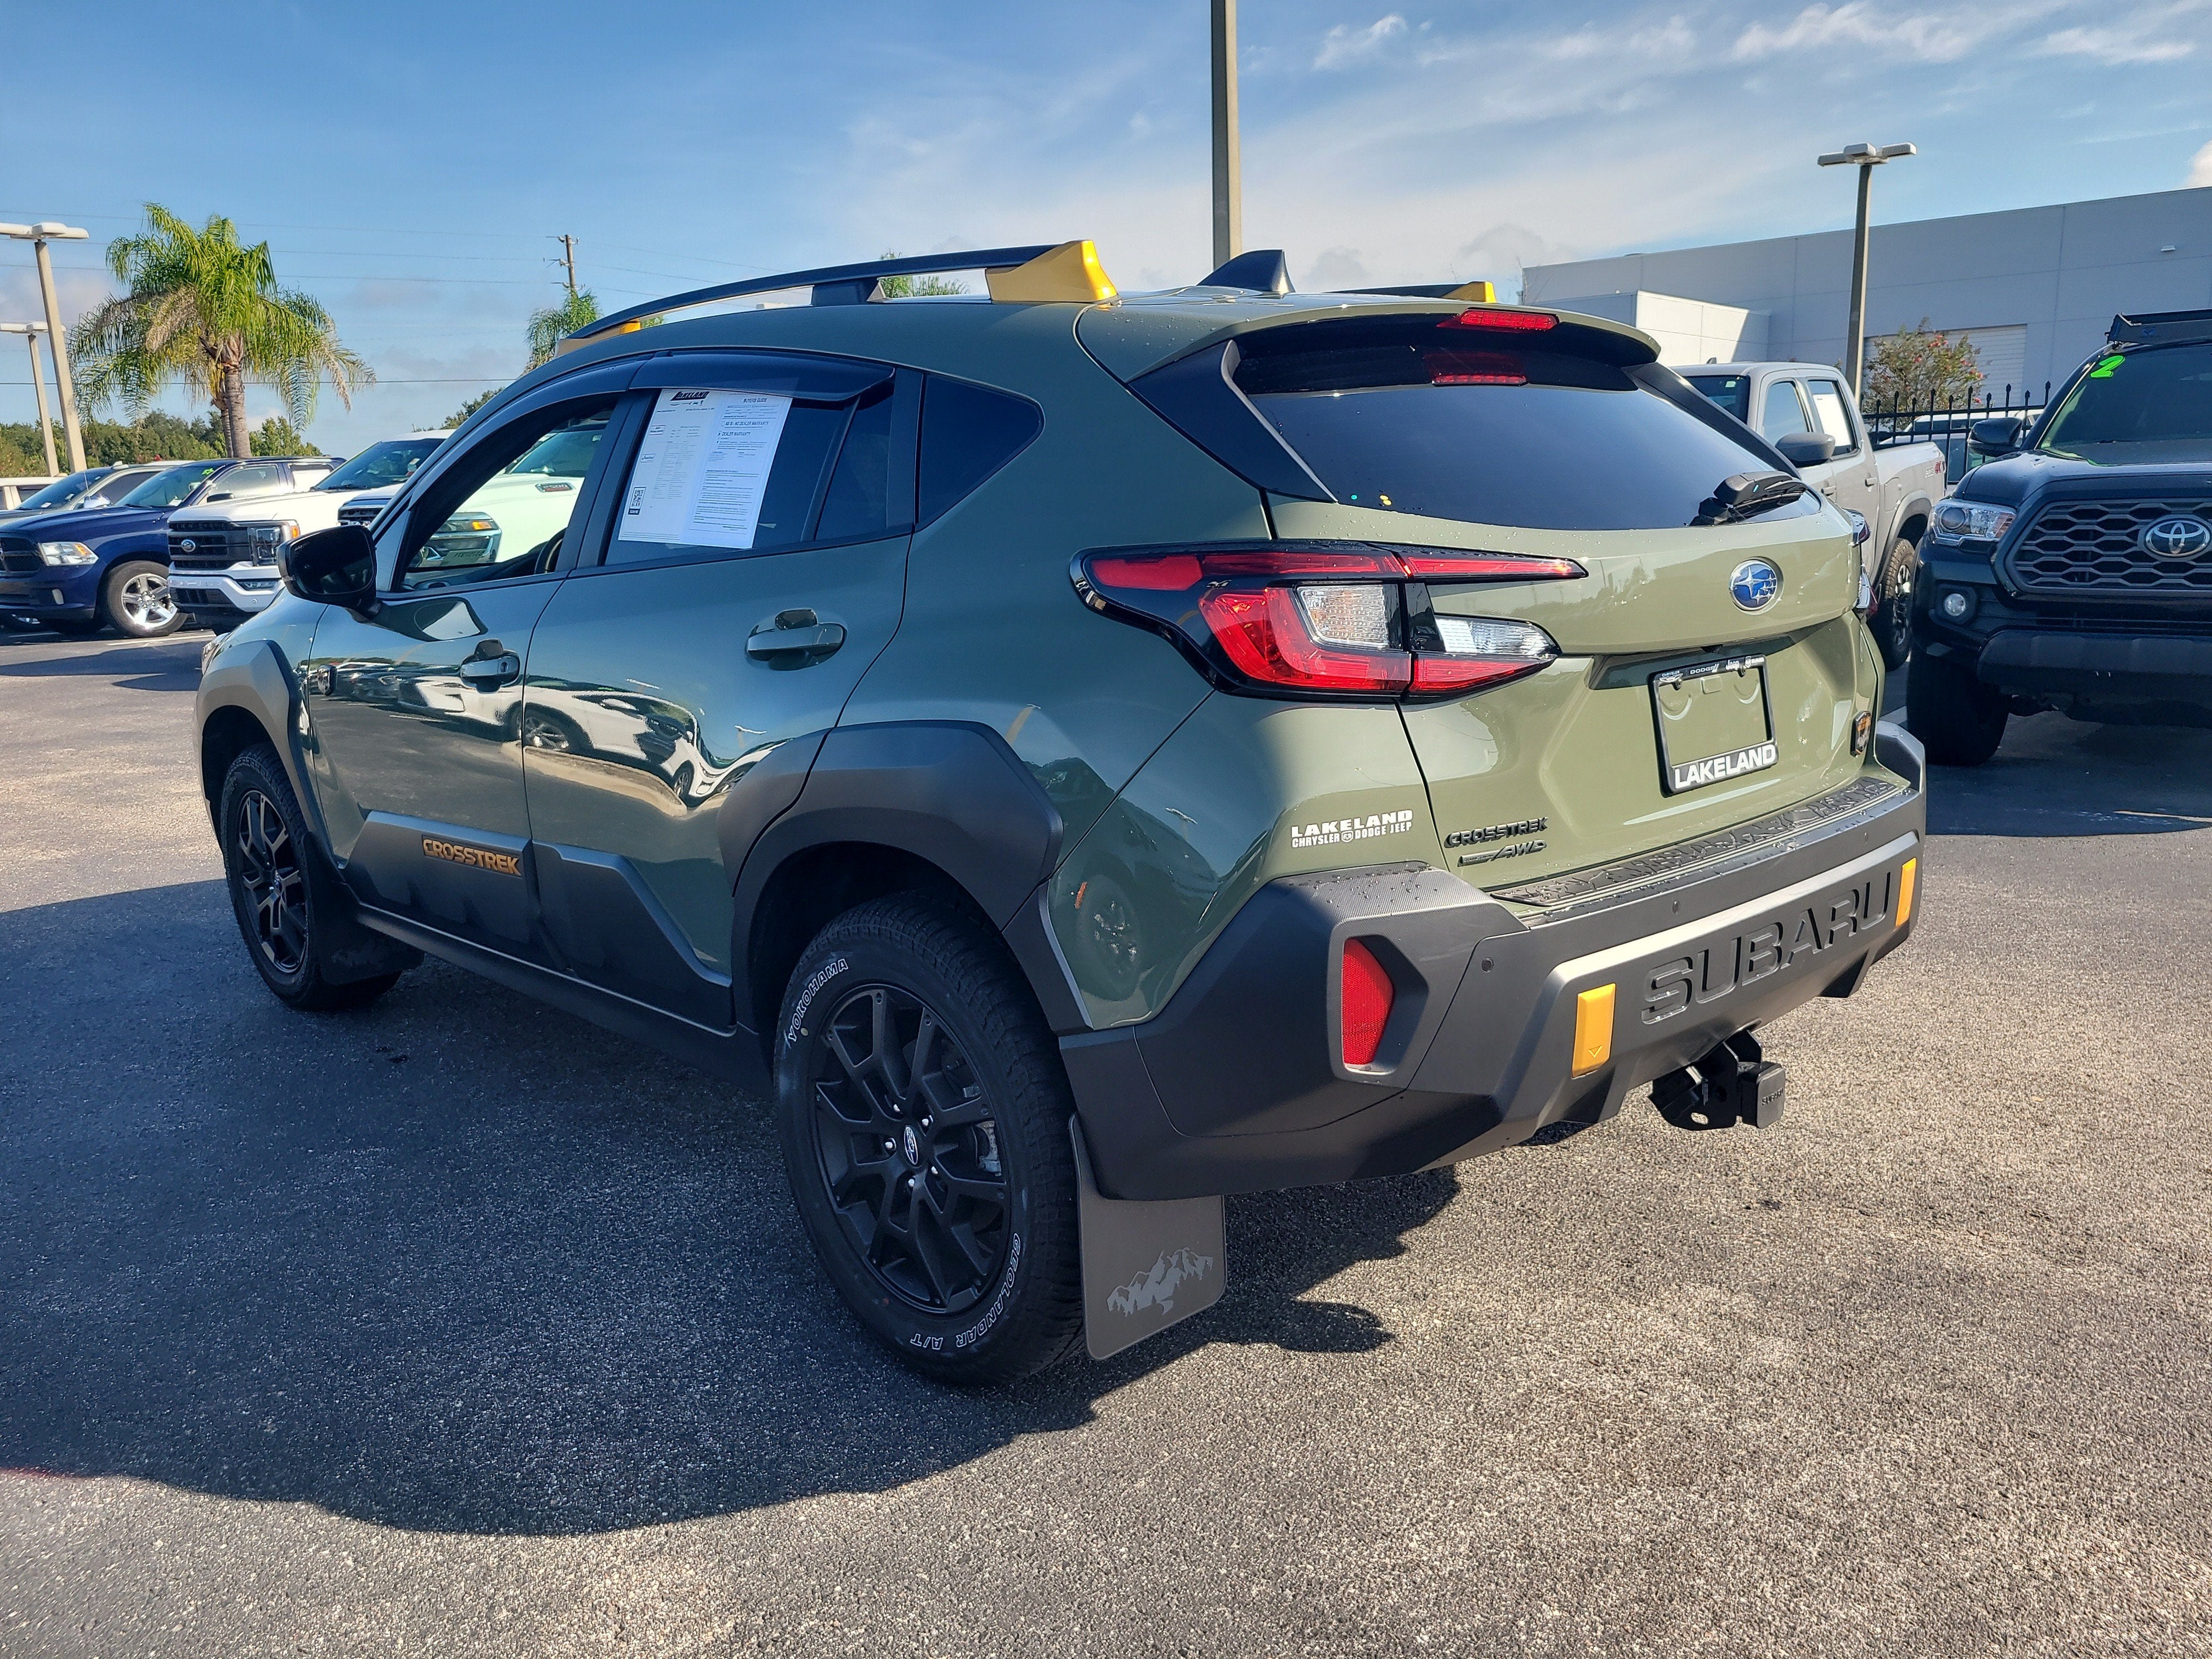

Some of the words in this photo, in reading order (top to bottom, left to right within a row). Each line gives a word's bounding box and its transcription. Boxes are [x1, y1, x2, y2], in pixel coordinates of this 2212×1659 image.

[2090, 355, 2126, 379] 2
[670, 391, 710, 401] LAKELAND
[1725, 659, 1740, 670] Jeep
[1675, 744, 1776, 789] LAKELAND
[1291, 810, 1413, 837] LAKELAND
[1292, 833, 1340, 848] CHRYSLER
[1355, 826, 1386, 839] DODGE
[1390, 821, 1412, 834] JEEP
[1445, 816, 1548, 848] CROSSTREK
[423, 839, 521, 876] CROSSTREK
[1496, 839, 1547, 858] AWD
[1641, 872, 1891, 1025] SUBARU
[788, 958, 849, 1042] YOKOHAMA
[956, 1233, 1020, 1347] GEOLANDAR
[910, 1333, 943, 1350] A/T
